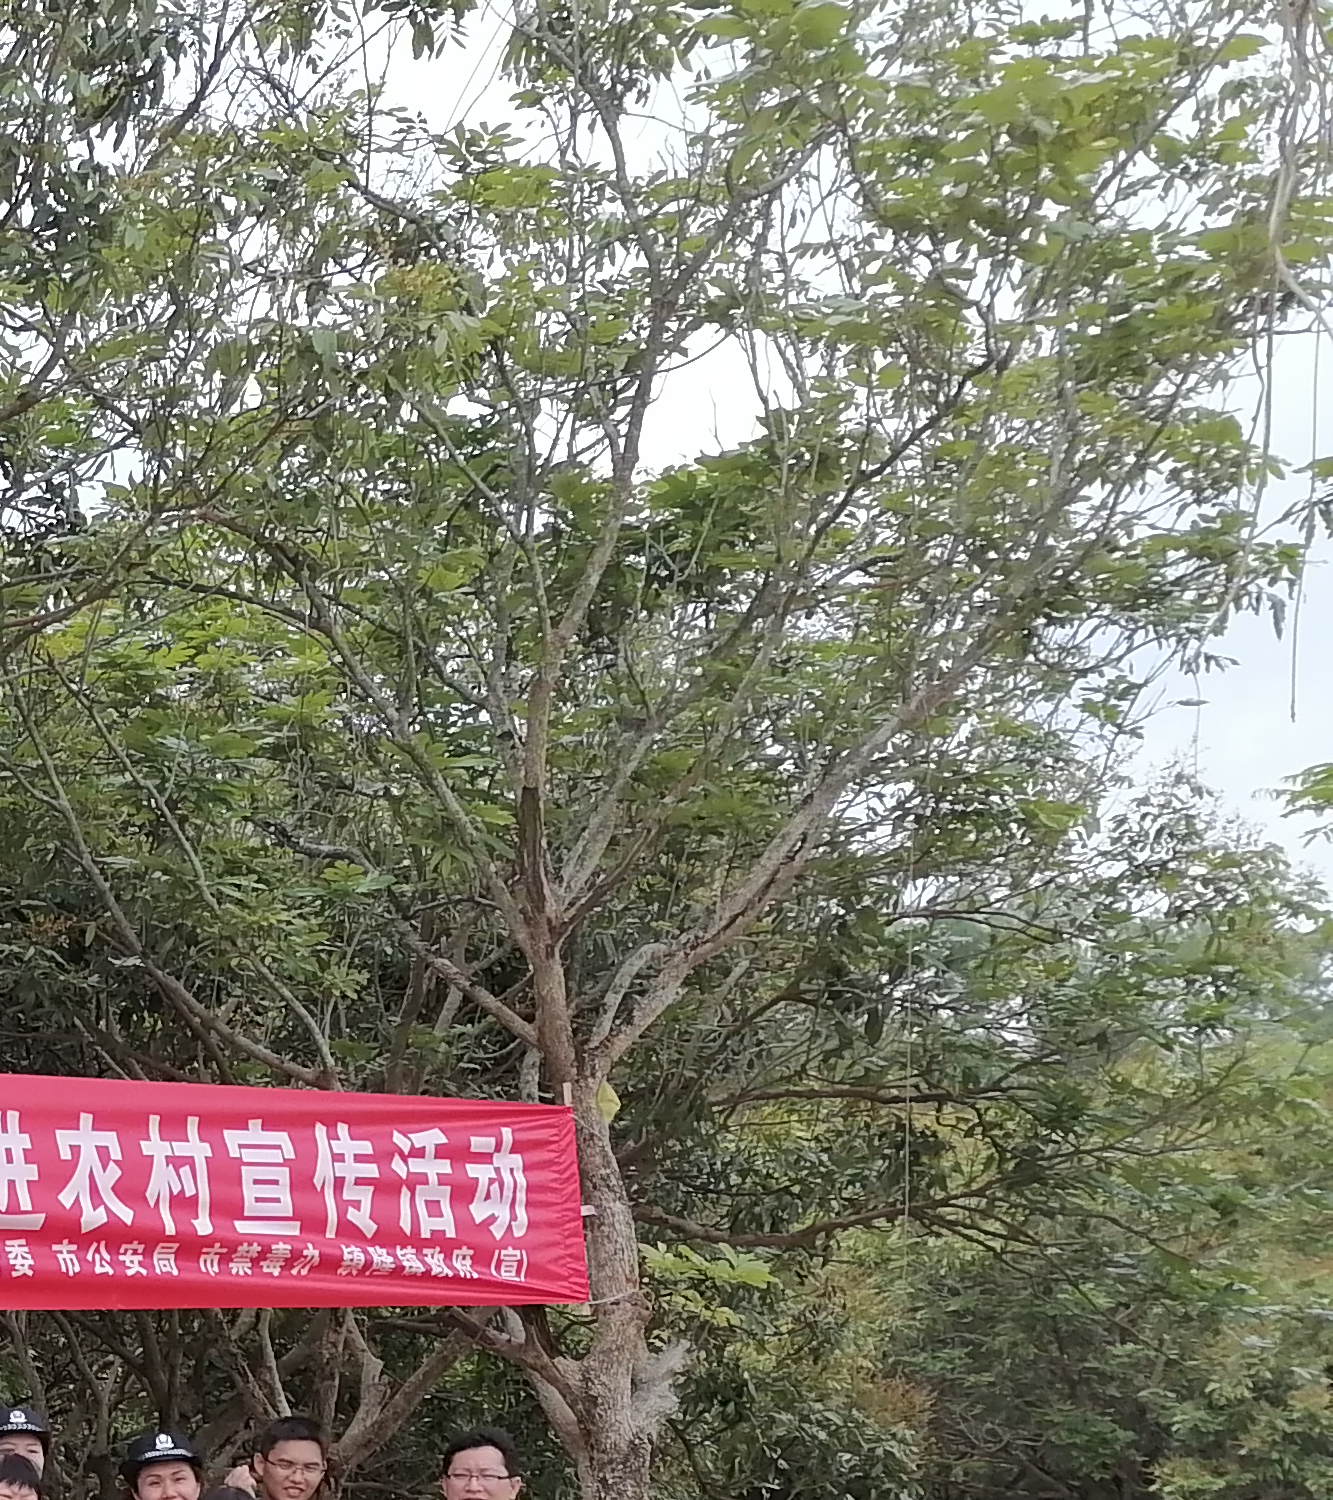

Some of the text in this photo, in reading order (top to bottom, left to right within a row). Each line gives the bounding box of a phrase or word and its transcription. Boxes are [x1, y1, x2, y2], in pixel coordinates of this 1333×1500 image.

[51, 1239, 179, 1278] 市公安局
[198, 1241, 320, 1278] 市禁毒办
